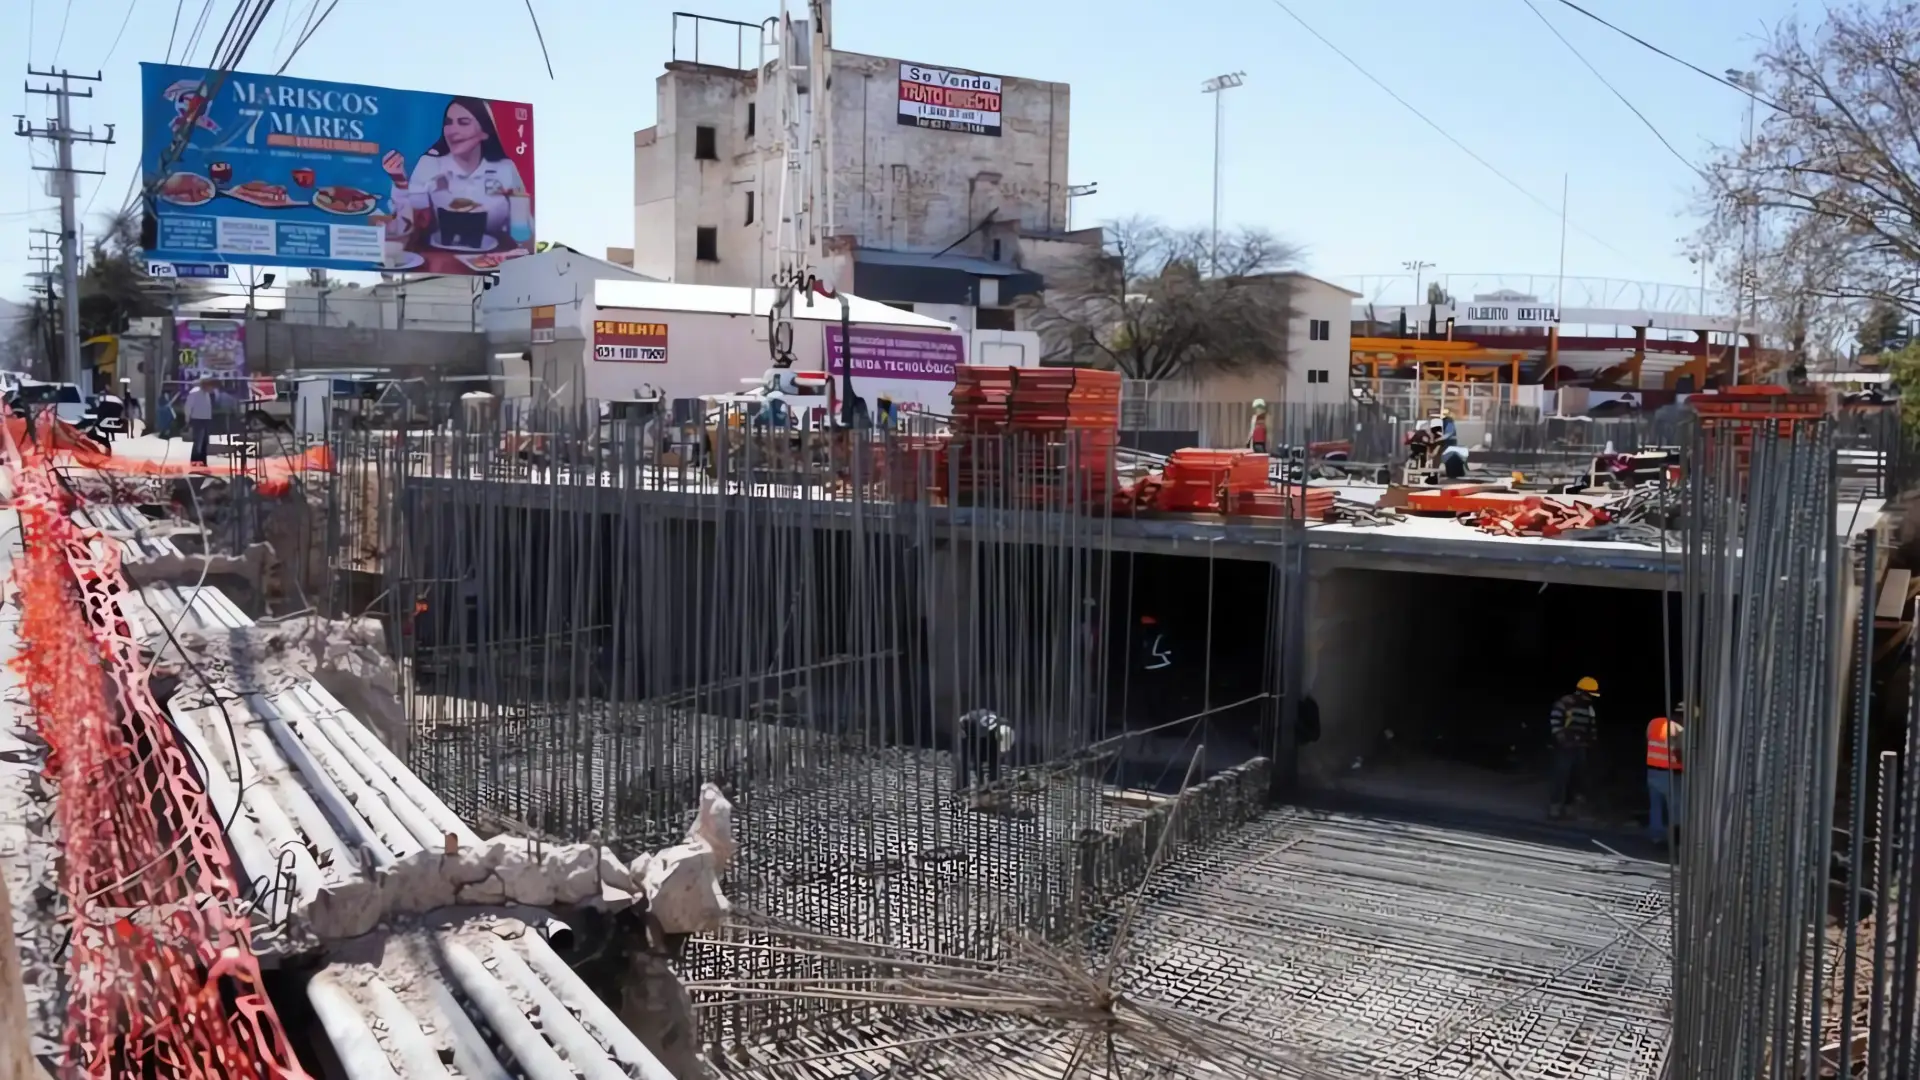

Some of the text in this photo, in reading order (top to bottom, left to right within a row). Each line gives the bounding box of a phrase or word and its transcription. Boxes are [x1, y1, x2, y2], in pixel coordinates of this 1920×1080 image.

[232, 80, 379, 116] MARISCOS
[945, 89, 1000, 111] DECTO
[238, 108, 264, 145] 7
[270, 111, 365, 141] MARES
[833, 357, 882, 370] AENIDA
